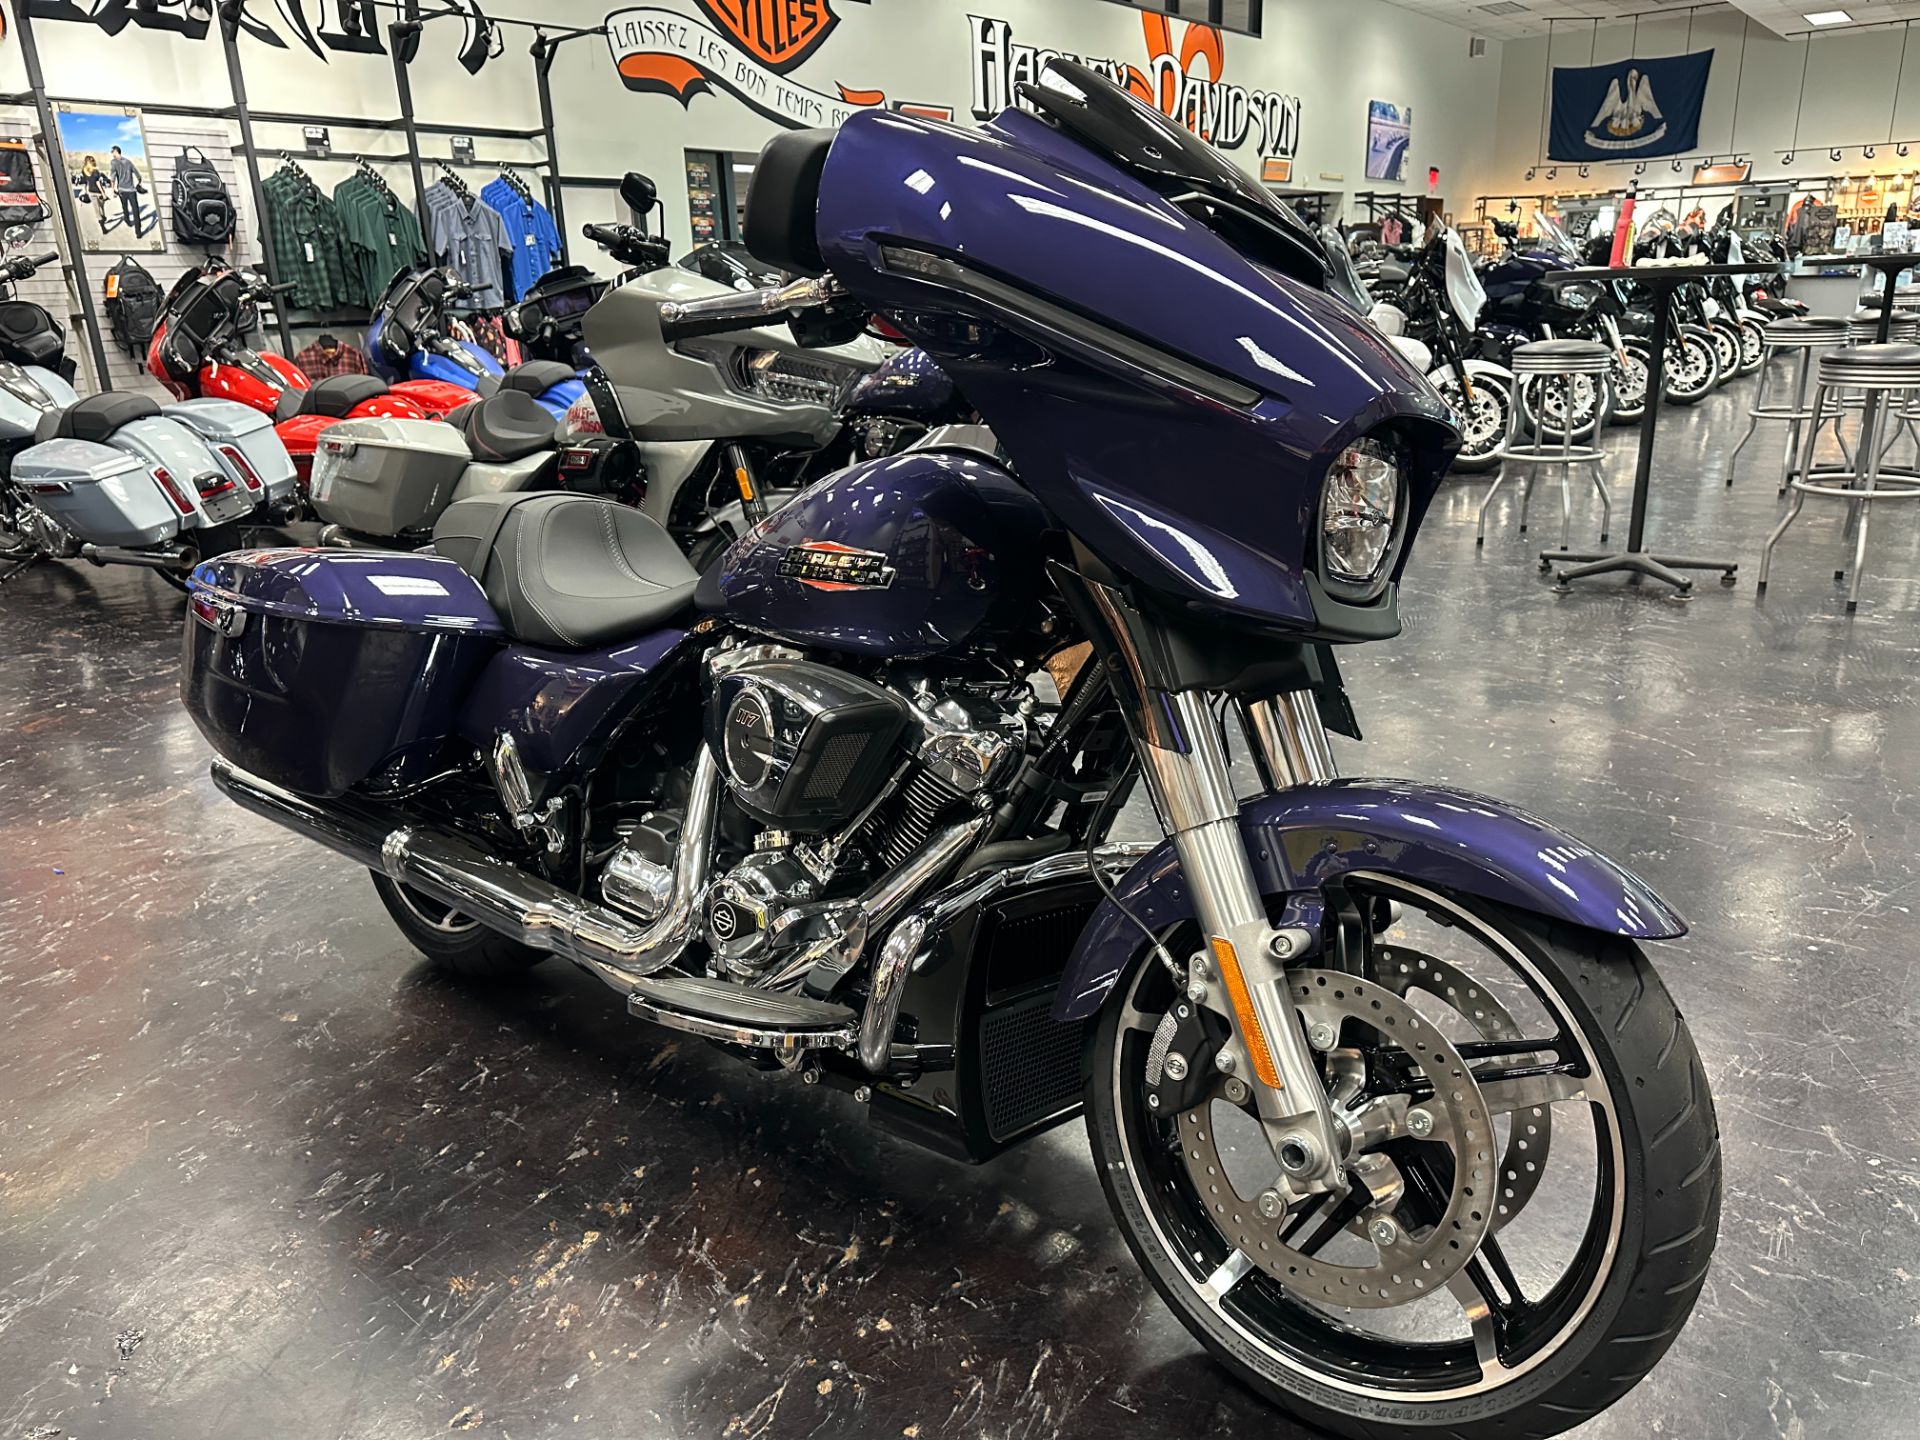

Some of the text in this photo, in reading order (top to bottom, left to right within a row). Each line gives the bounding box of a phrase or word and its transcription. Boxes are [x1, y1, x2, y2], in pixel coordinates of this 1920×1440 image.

[613, 20, 688, 49] LAISSEZ
[698, 35, 728, 71] LES
[735, 62, 768, 97] BON
[775, 85, 822, 123] TEMPS
[1150, 53, 1301, 158] DAVIDSON
[786, 550, 880, 568] HARLEY-
[735, 707, 761, 728] 117
